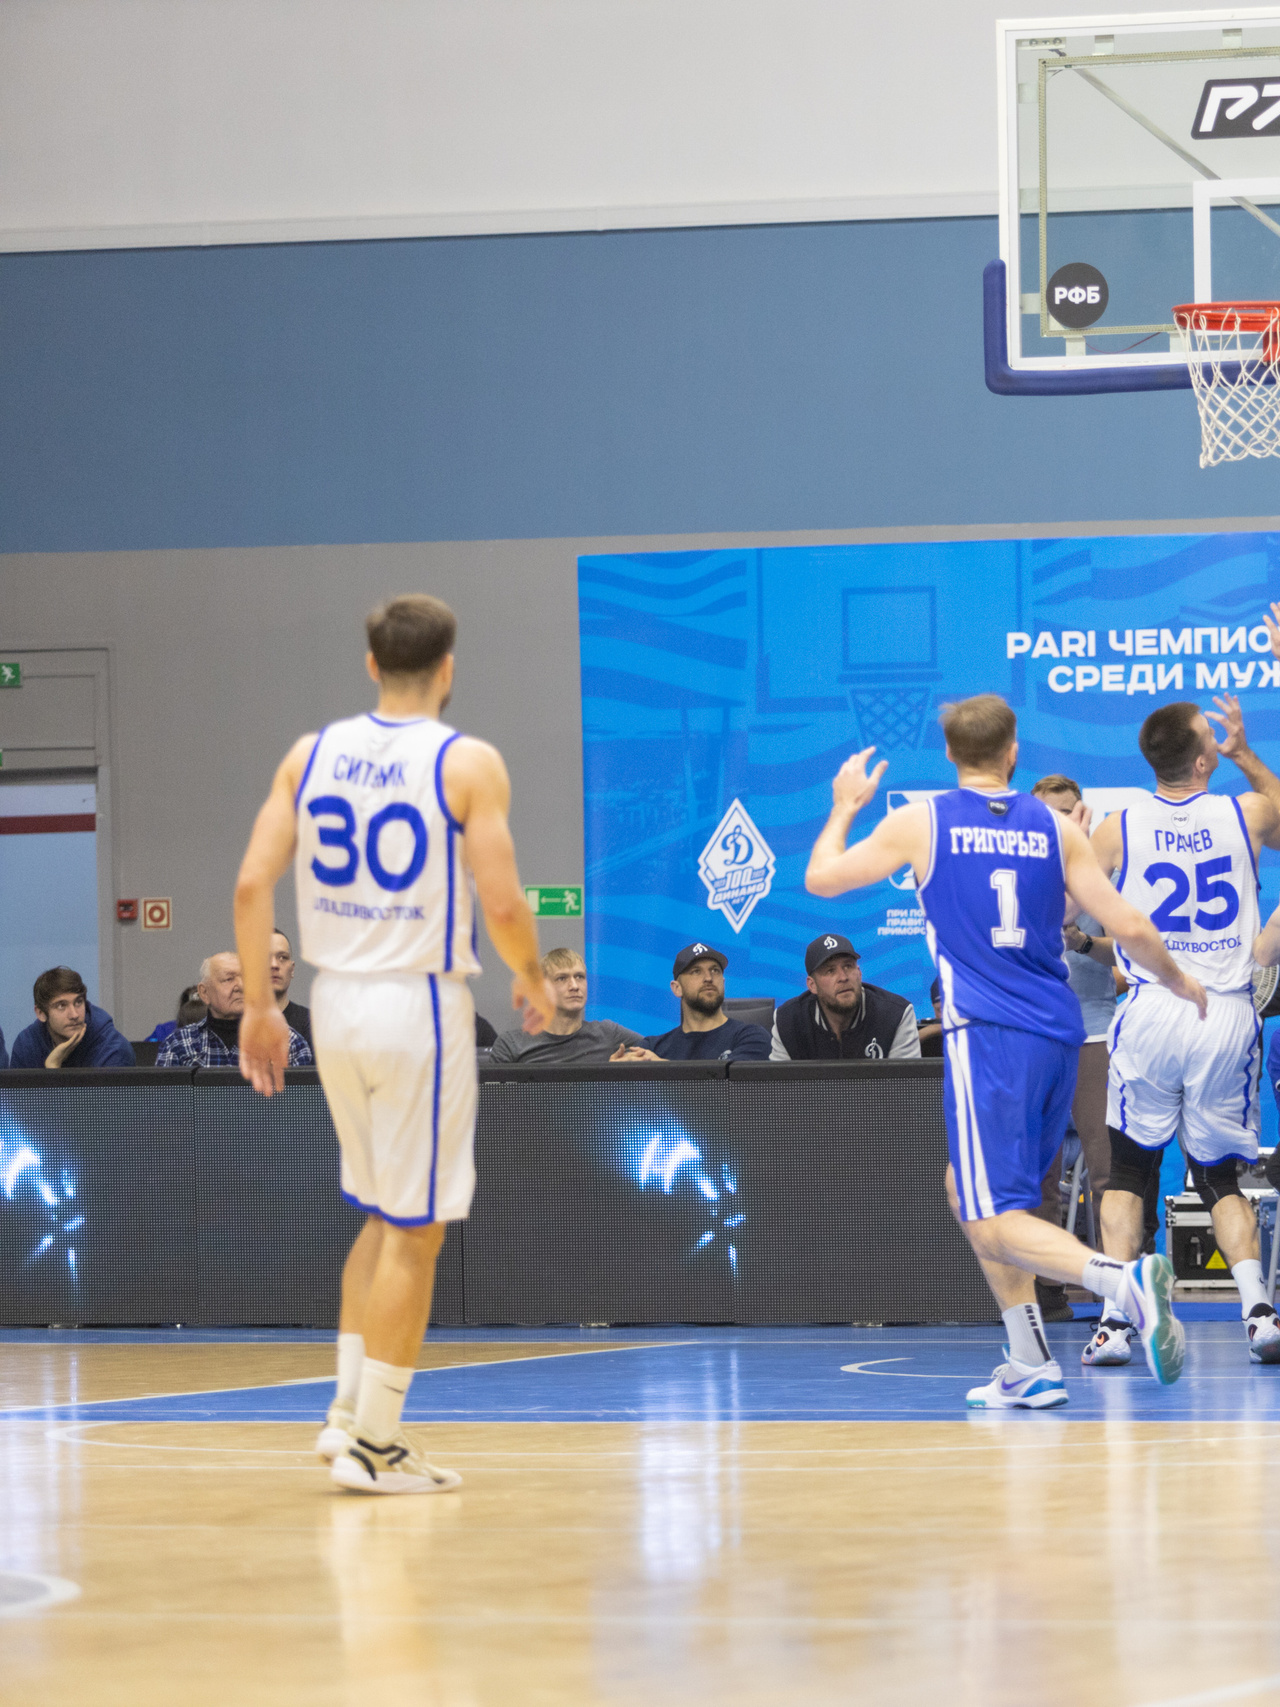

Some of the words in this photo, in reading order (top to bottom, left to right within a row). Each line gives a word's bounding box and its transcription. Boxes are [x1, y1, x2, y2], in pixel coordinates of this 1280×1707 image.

[1054, 286, 1100, 305] РФБ
[1007, 630, 1096, 659] PARI
[1047, 663, 1183, 695] СРЕДИ
[307, 795, 428, 892] 30
[950, 826, 1048, 858] ГРИГОРЬЕВ
[1154, 828, 1213, 854] ГРАЧЕВ
[990, 869, 1026, 948] 1
[1143, 855, 1240, 932] 25
[878, 927, 926, 935] ПРИМОРС
[1165, 935, 1242, 953] АДИВОСТО
